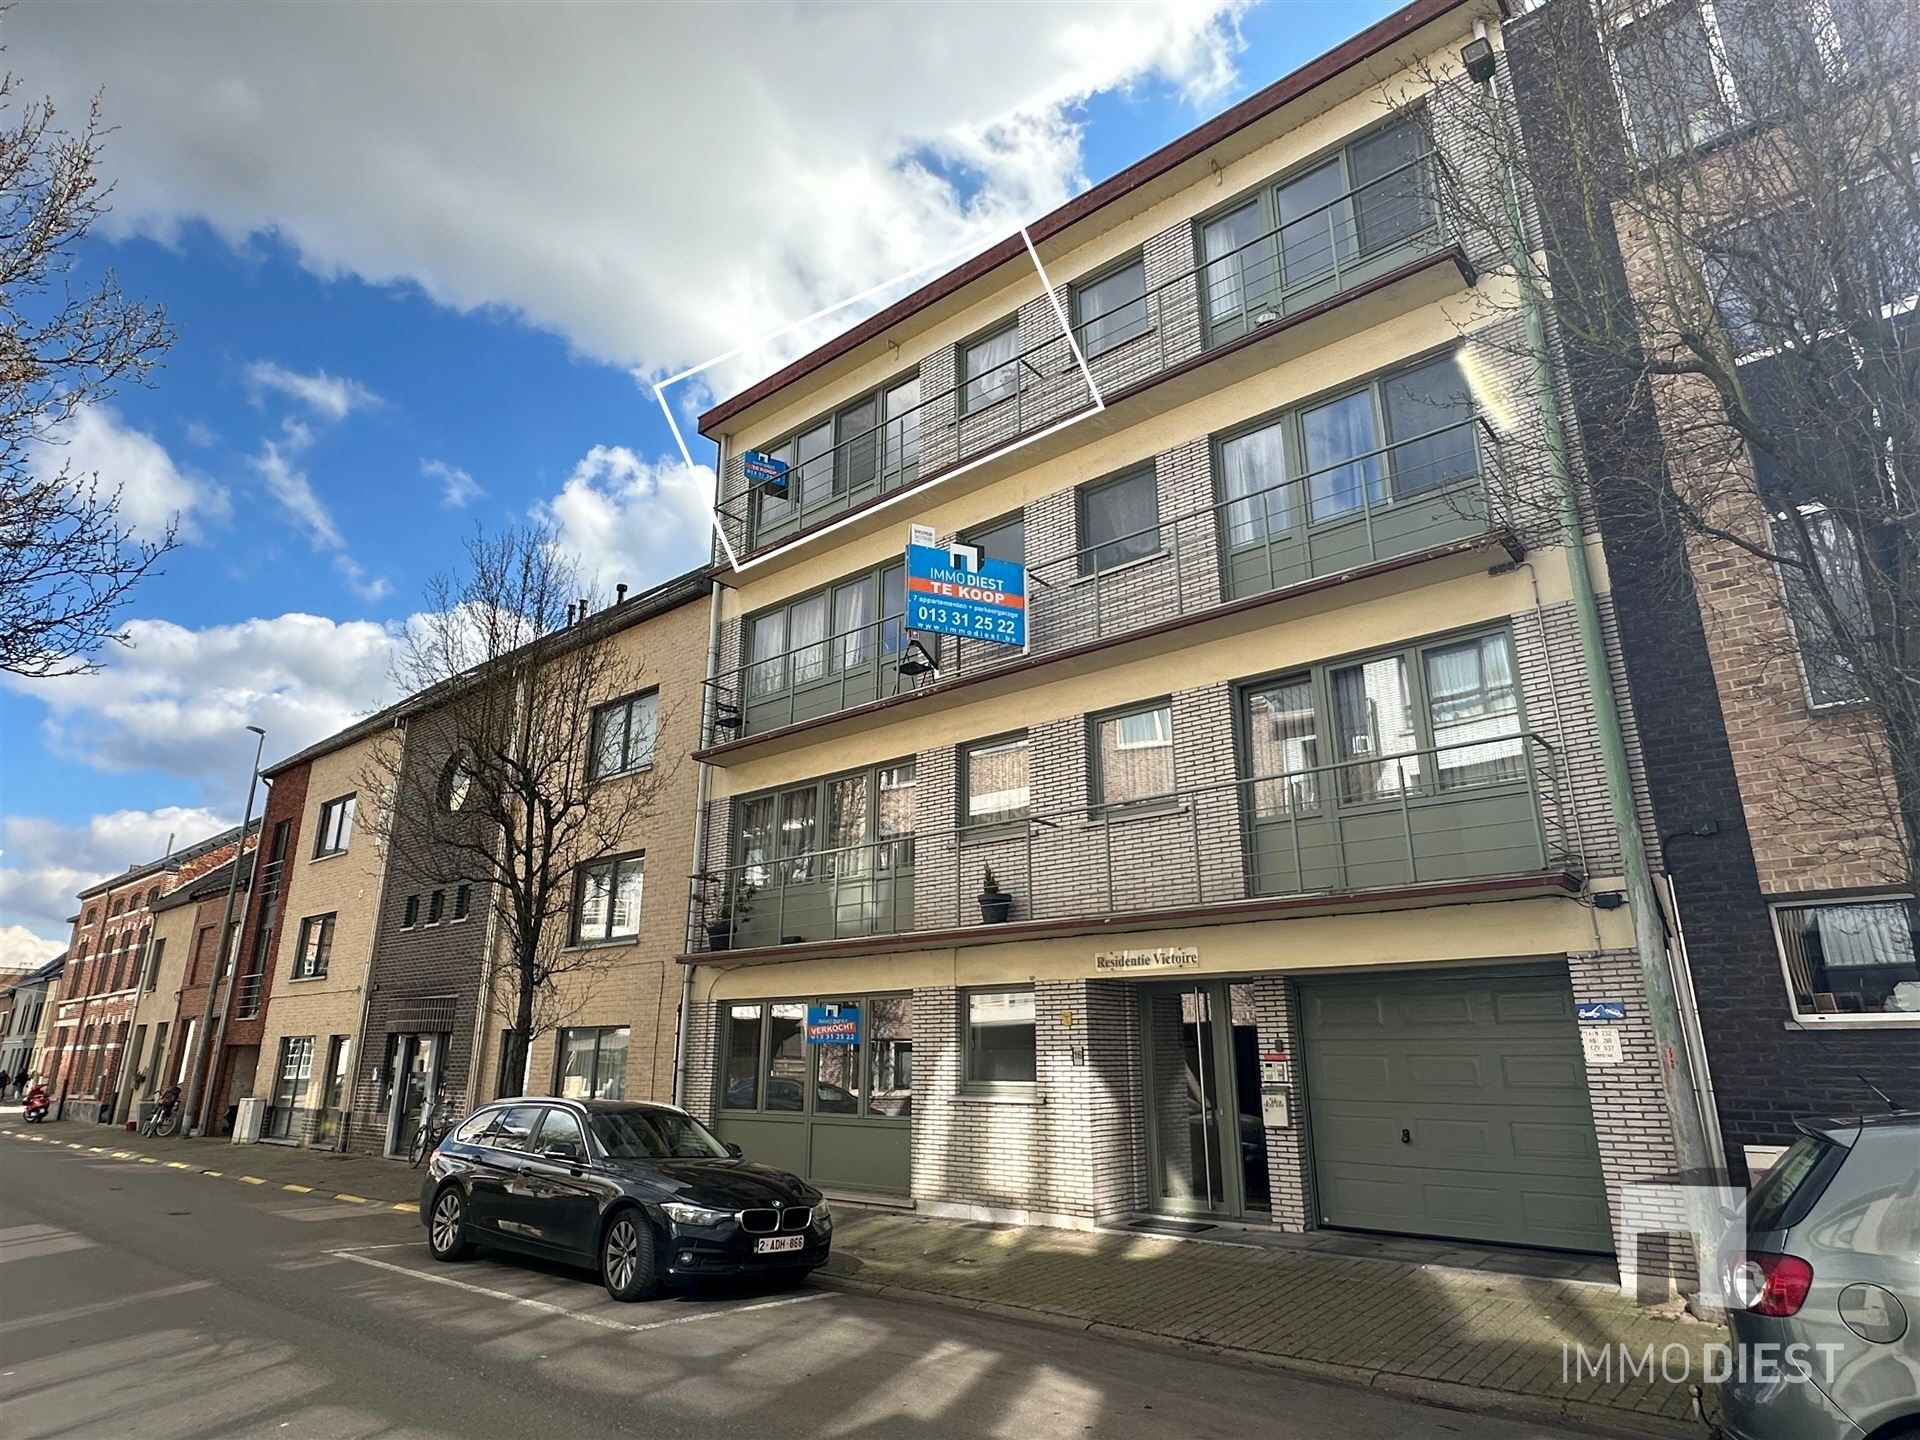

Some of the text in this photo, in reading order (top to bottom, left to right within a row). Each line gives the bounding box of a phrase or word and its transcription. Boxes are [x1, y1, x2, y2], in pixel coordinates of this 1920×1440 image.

[930, 568, 1004, 592] IMMO DIEST
[930, 581, 1005, 604] TE KOOP
[919, 596, 967, 609] appartementen
[974, 605, 1018, 619] parkeergarage
[918, 606, 1015, 634] 013 31 25 22
[1096, 954, 1151, 968] Residentie
[811, 1022, 854, 1035] VERKOCHT
